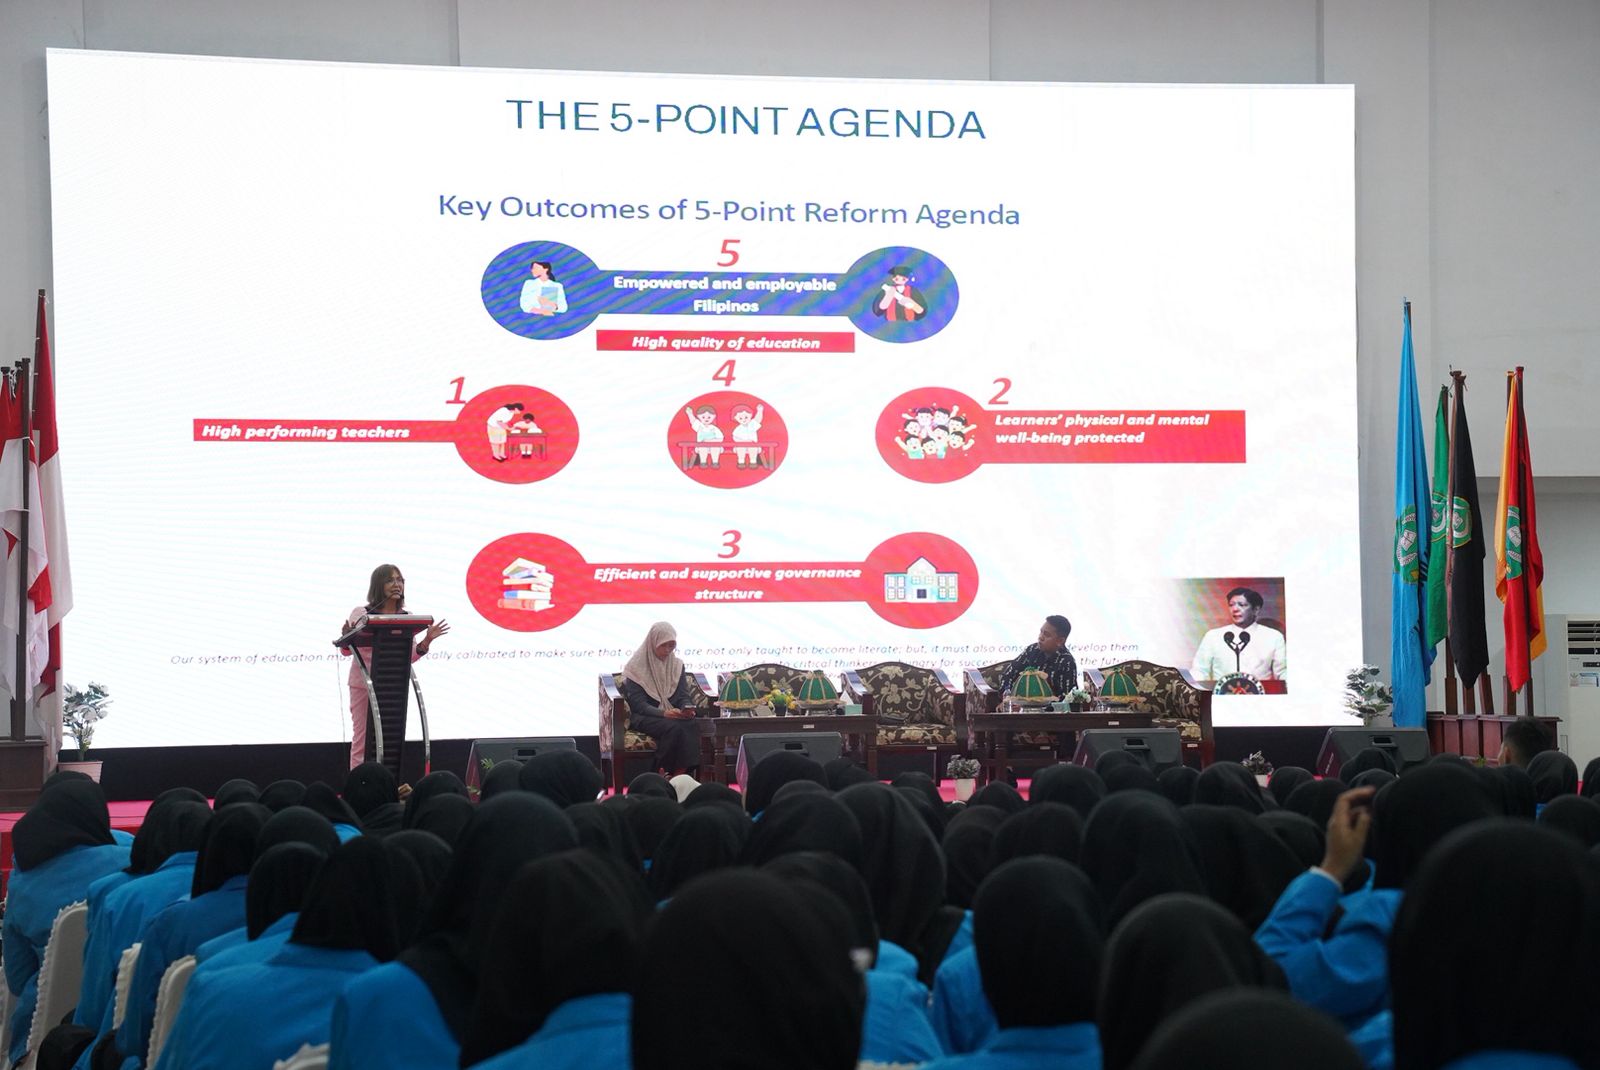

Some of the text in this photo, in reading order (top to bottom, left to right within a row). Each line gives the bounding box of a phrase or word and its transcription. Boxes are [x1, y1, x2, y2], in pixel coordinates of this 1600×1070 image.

[506, 100, 985, 139] THE 5-POINT AGENDA
[440, 195, 1019, 228] Key Outcomes of 5-Point Reform Agenda
[717, 239, 741, 266] 5
[614, 276, 837, 294] Empowered and employable
[693, 299, 760, 314] Filipinos
[632, 336, 821, 351] High quality of education
[712, 359, 736, 386] 4
[445, 376, 467, 404] 1
[988, 377, 1012, 405] 2
[1065, 414, 1124, 427] physical
[1127, 414, 1155, 425] and
[1158, 414, 1209, 425] mental
[202, 425, 409, 440] High performing teachers
[996, 432, 1144, 445] well-being protected
[717, 530, 742, 559] 3
[594, 568, 861, 582] Efficient and supportive governance
[695, 589, 764, 600] structure
[170, 655, 193, 665] Our
[198, 655, 241, 665] system
[245, 653, 258, 665] of
[262, 653, 323, 663] education
[327, 653, 351, 662] mus
[456, 649, 516, 660] calibrated
[519, 650, 531, 659] to
[534, 648, 567, 658] make
[570, 649, 595, 658] sure
[598, 648, 622, 657] that
[684, 648, 702, 656] are
[706, 647, 725, 655] not
[728, 646, 752, 656] only
[756, 646, 793, 656] taught
[797, 646, 808, 655] to
[811, 646, 855, 655] become
[931, 645, 939, 653] it
[942, 645, 970, 653] must
[973, 644, 996, 653] also
[1110, 643, 1139, 652] them
[940, 658, 955, 669] for
[1080, 657, 1098, 666] the
